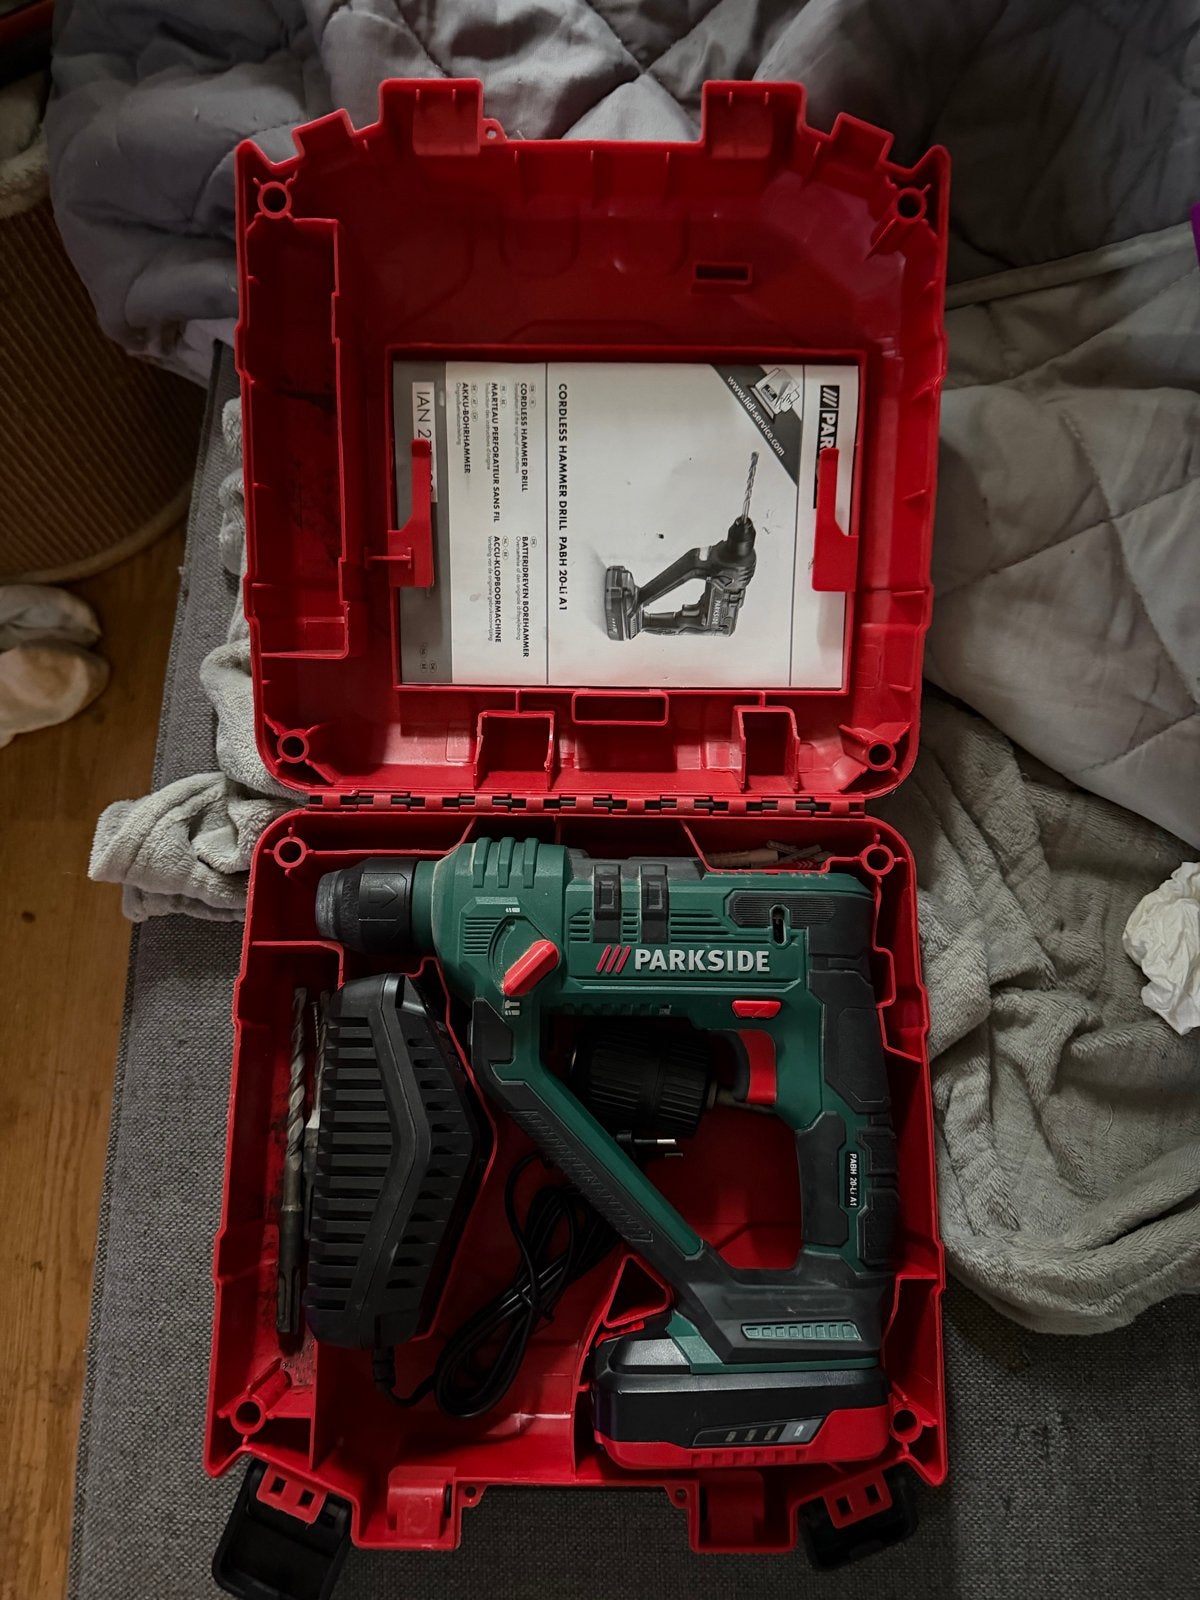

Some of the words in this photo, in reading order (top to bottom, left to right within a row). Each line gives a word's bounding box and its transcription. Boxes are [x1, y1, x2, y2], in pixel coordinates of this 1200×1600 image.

[416, 392, 431, 422] IAN
[520, 383, 528, 426] CORDLESS
[559, 384, 567, 442] CORDLESS
[727, 376, 786, 456] www.lidl-service.com
[462, 383, 470, 474] AKKU-BOHRHAMMER
[559, 446, 567, 496] HAMMER
[559, 501, 567, 531] DRILL
[559, 537, 567, 566] PABH
[559, 570, 568, 594] 20-Li
[559, 597, 567, 610] A1
[635, 949, 770, 973] PARKSIDE
[850, 1197, 857, 1206] A1
